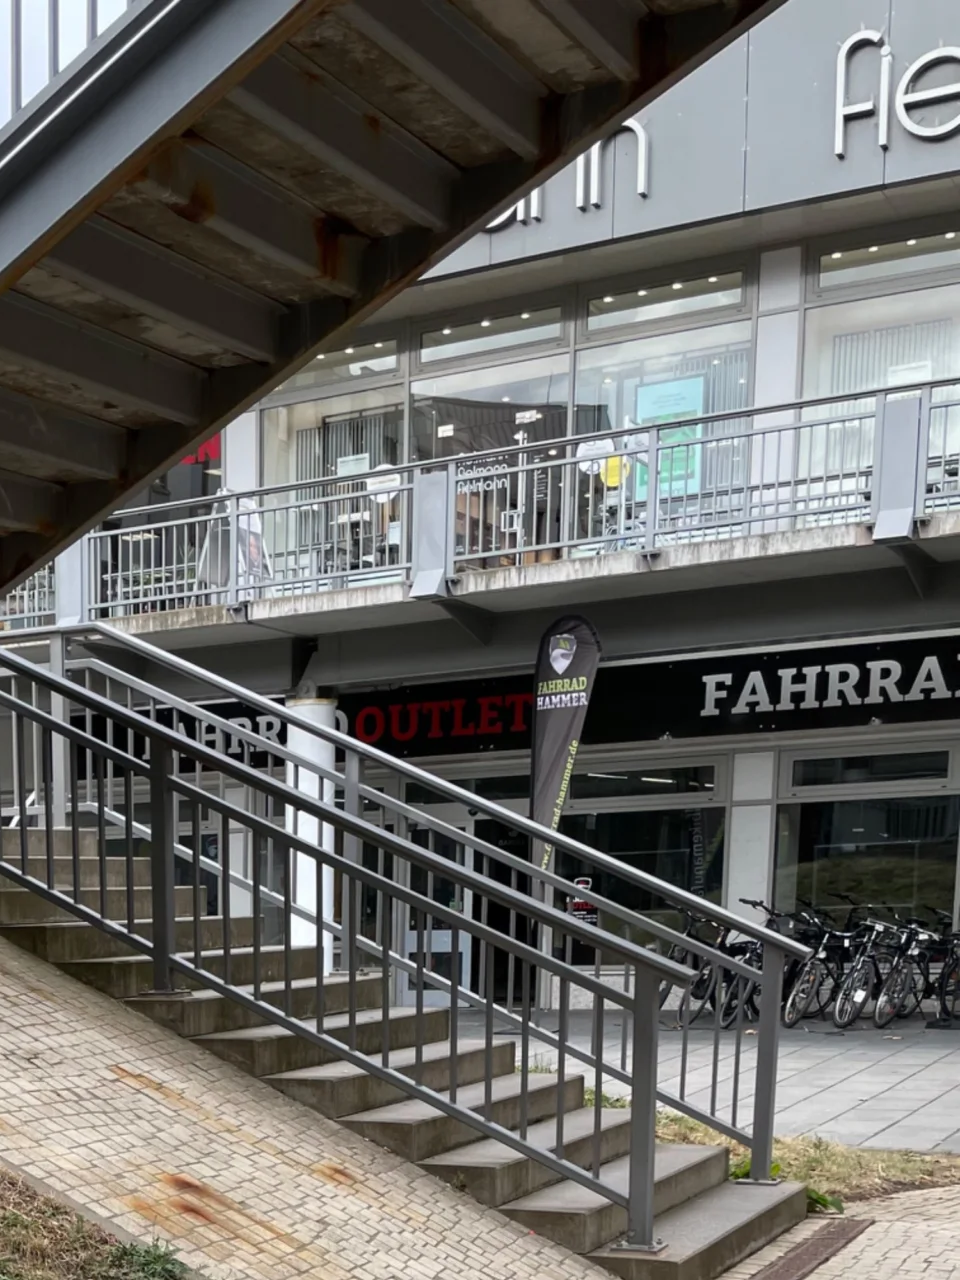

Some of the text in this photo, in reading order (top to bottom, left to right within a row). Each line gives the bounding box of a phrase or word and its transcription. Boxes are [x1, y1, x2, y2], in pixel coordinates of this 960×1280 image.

[536, 692, 588, 710] HAMMER
[537, 676, 587, 694] FAHRRAD
[700, 653, 960, 717] FAHRRA
[355, 693, 534, 744] OUTLET
